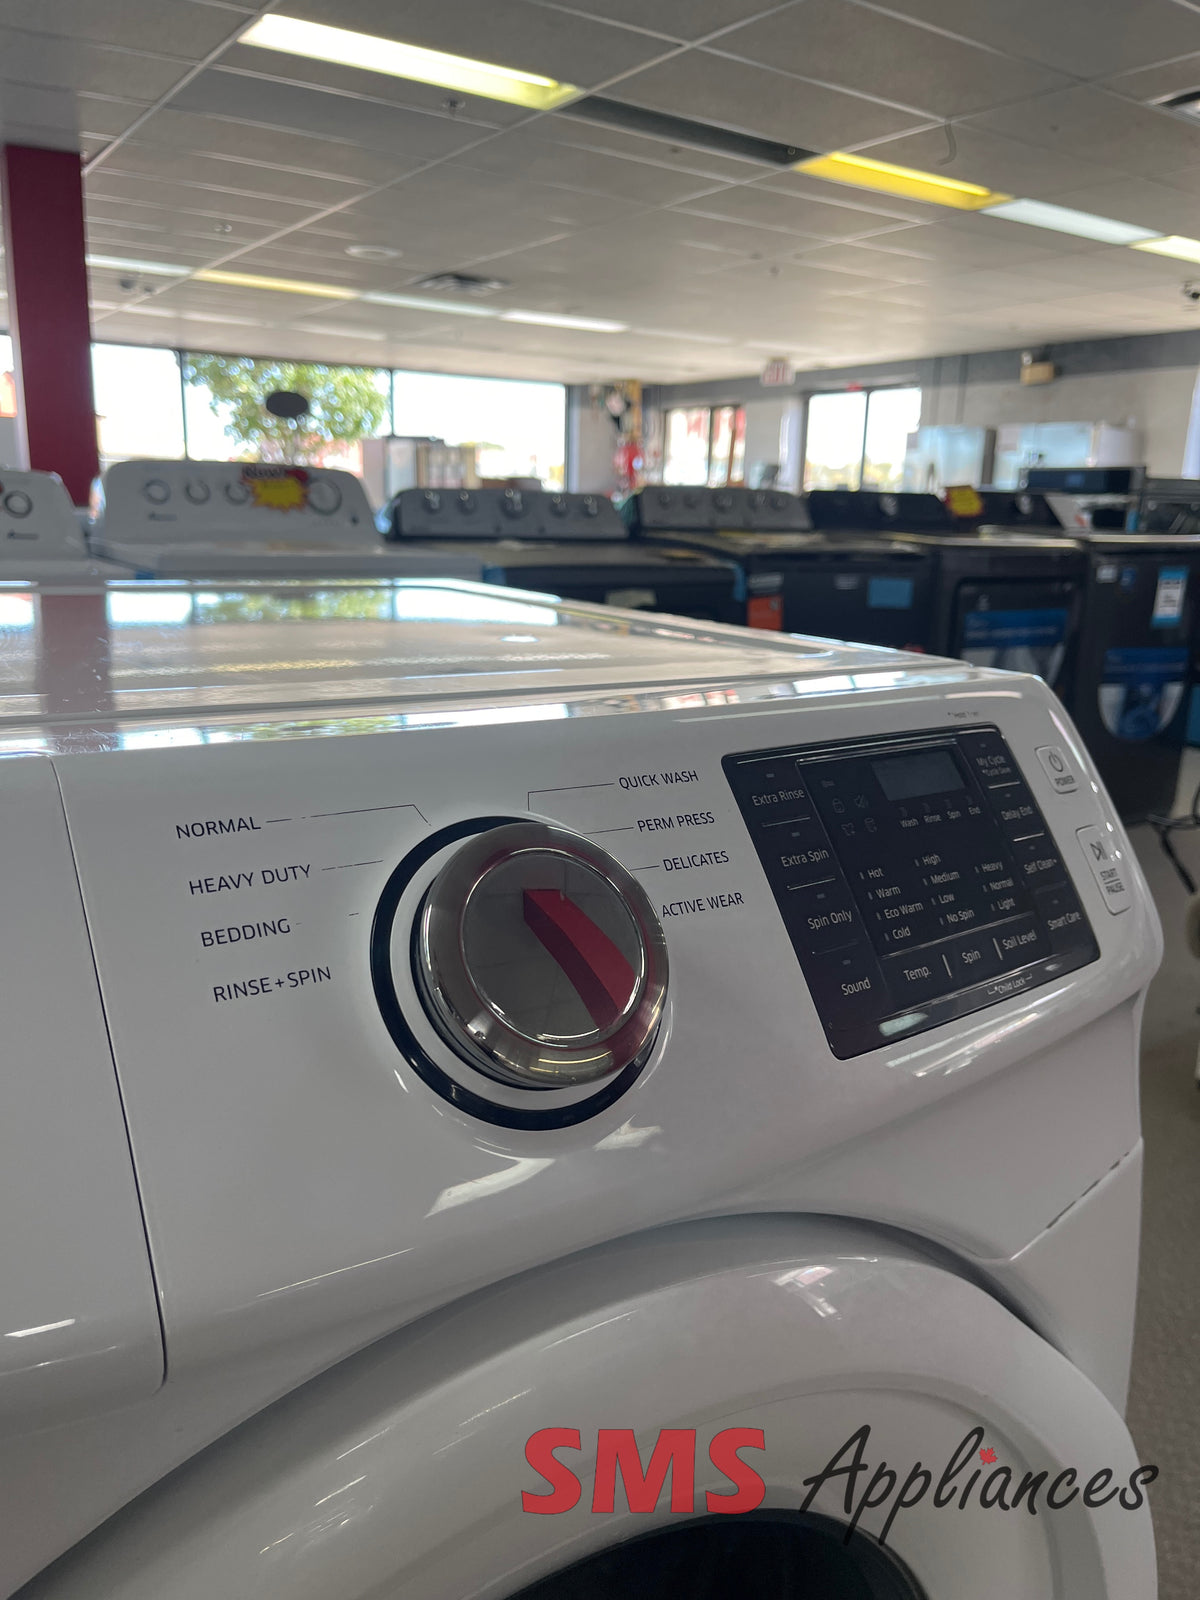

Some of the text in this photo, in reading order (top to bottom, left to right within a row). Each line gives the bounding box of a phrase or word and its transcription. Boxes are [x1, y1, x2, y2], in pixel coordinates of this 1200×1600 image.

[619, 770, 699, 791] QUICK WASH
[1054, 775, 1076, 787] POWER
[752, 789, 805, 807] Extra Rinse
[637, 811, 715, 833] PERM PRESS
[900, 817, 919, 829] Wash
[1001, 809, 1021, 822] Delay
[176, 816, 261, 839] NORMAL
[663, 850, 730, 872] DELICATES
[781, 848, 830, 868] Extra Spin
[922, 853, 942, 866] High
[867, 867, 884, 879] Hot
[1024, 863, 1038, 875] Self
[1100, 867, 1119, 881] START
[188, 864, 311, 896] HEAVY DUTY
[930, 870, 960, 885] Medium
[989, 877, 1014, 891] Normal
[875, 885, 901, 899] Warm
[1105, 882, 1125, 895] PAUSE
[661, 892, 745, 918] ACTIVE WEAR
[938, 892, 955, 904] Low
[997, 897, 1015, 911] Light
[884, 902, 924, 919] Eco Warm
[946, 908, 975, 924] No Spin
[807, 910, 853, 930] Spin Only
[1047, 910, 1081, 931] Smart Care
[200, 918, 291, 948] BEDDING
[892, 926, 911, 940] Cold
[1002, 930, 1038, 950] Soil Level
[961, 949, 981, 964] Spin
[903, 965, 932, 981] Temp.
[213, 966, 332, 1003] RINSE+SPIN
[841, 976, 872, 996] Sound
